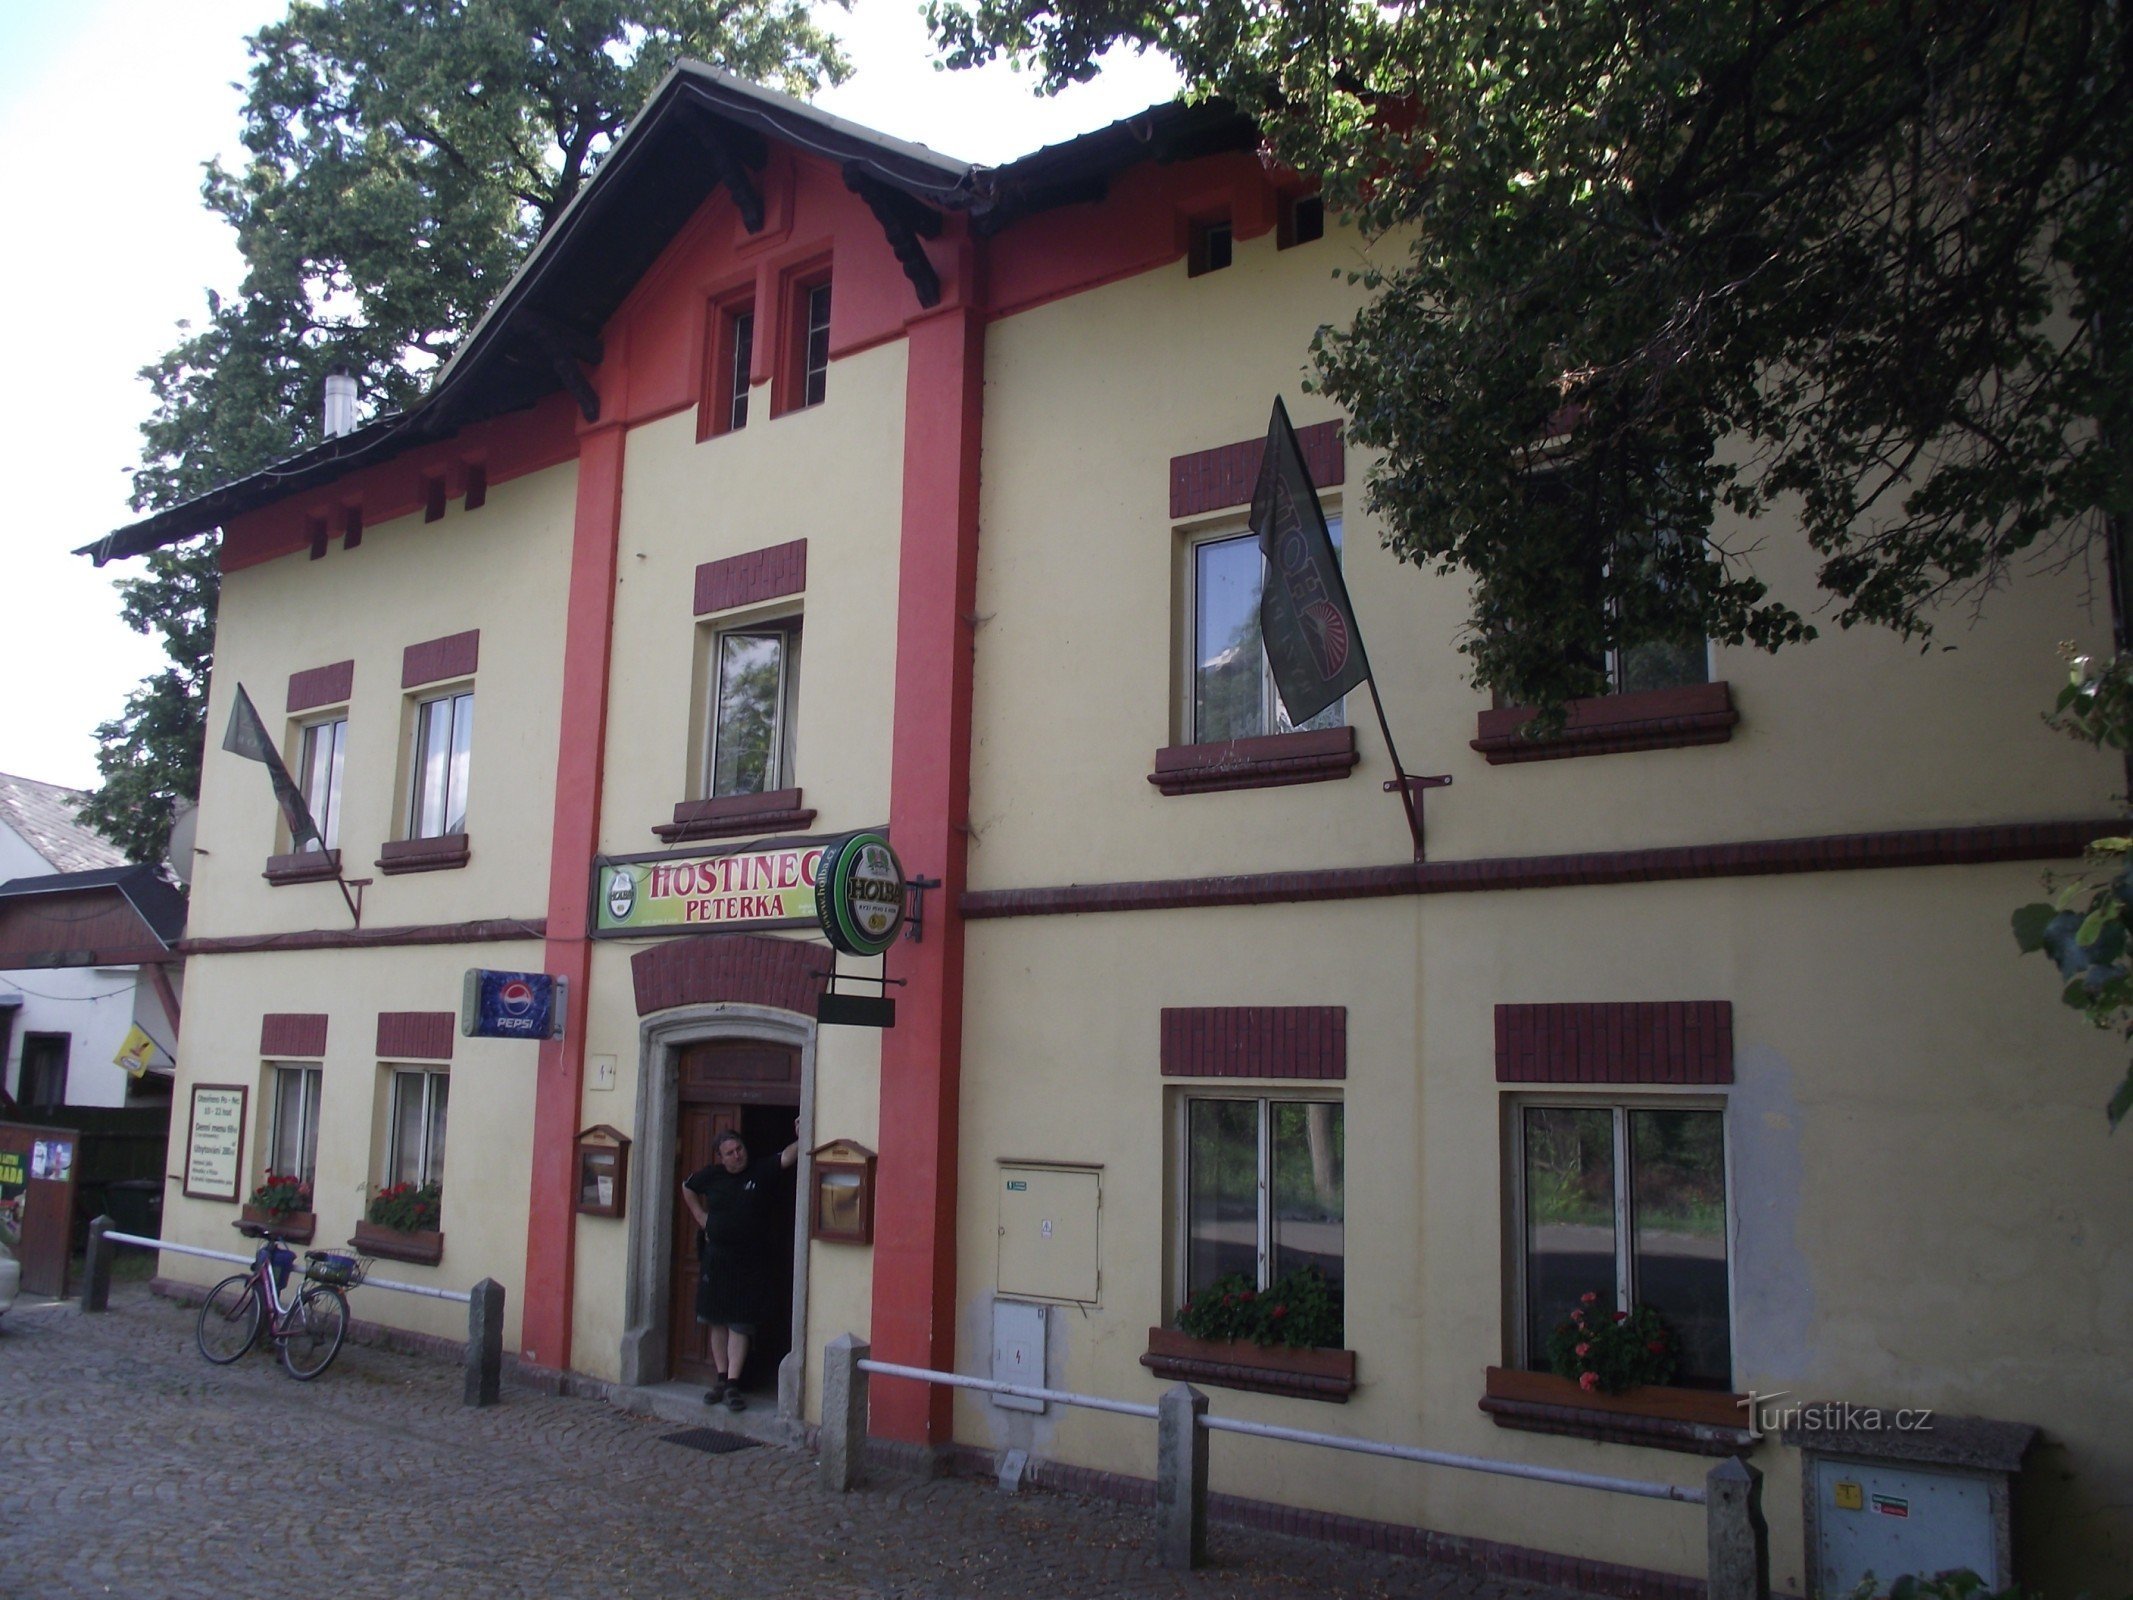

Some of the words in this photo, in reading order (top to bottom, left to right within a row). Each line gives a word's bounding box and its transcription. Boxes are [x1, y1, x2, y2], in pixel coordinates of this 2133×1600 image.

[649, 849, 825, 898] HOSTINEC
[816, 848, 837, 929] www.holba.cz
[848, 877, 903, 906] HOLBA
[685, 894, 785, 922] PETERKA
[497, 1017, 533, 1029] PEPSI
